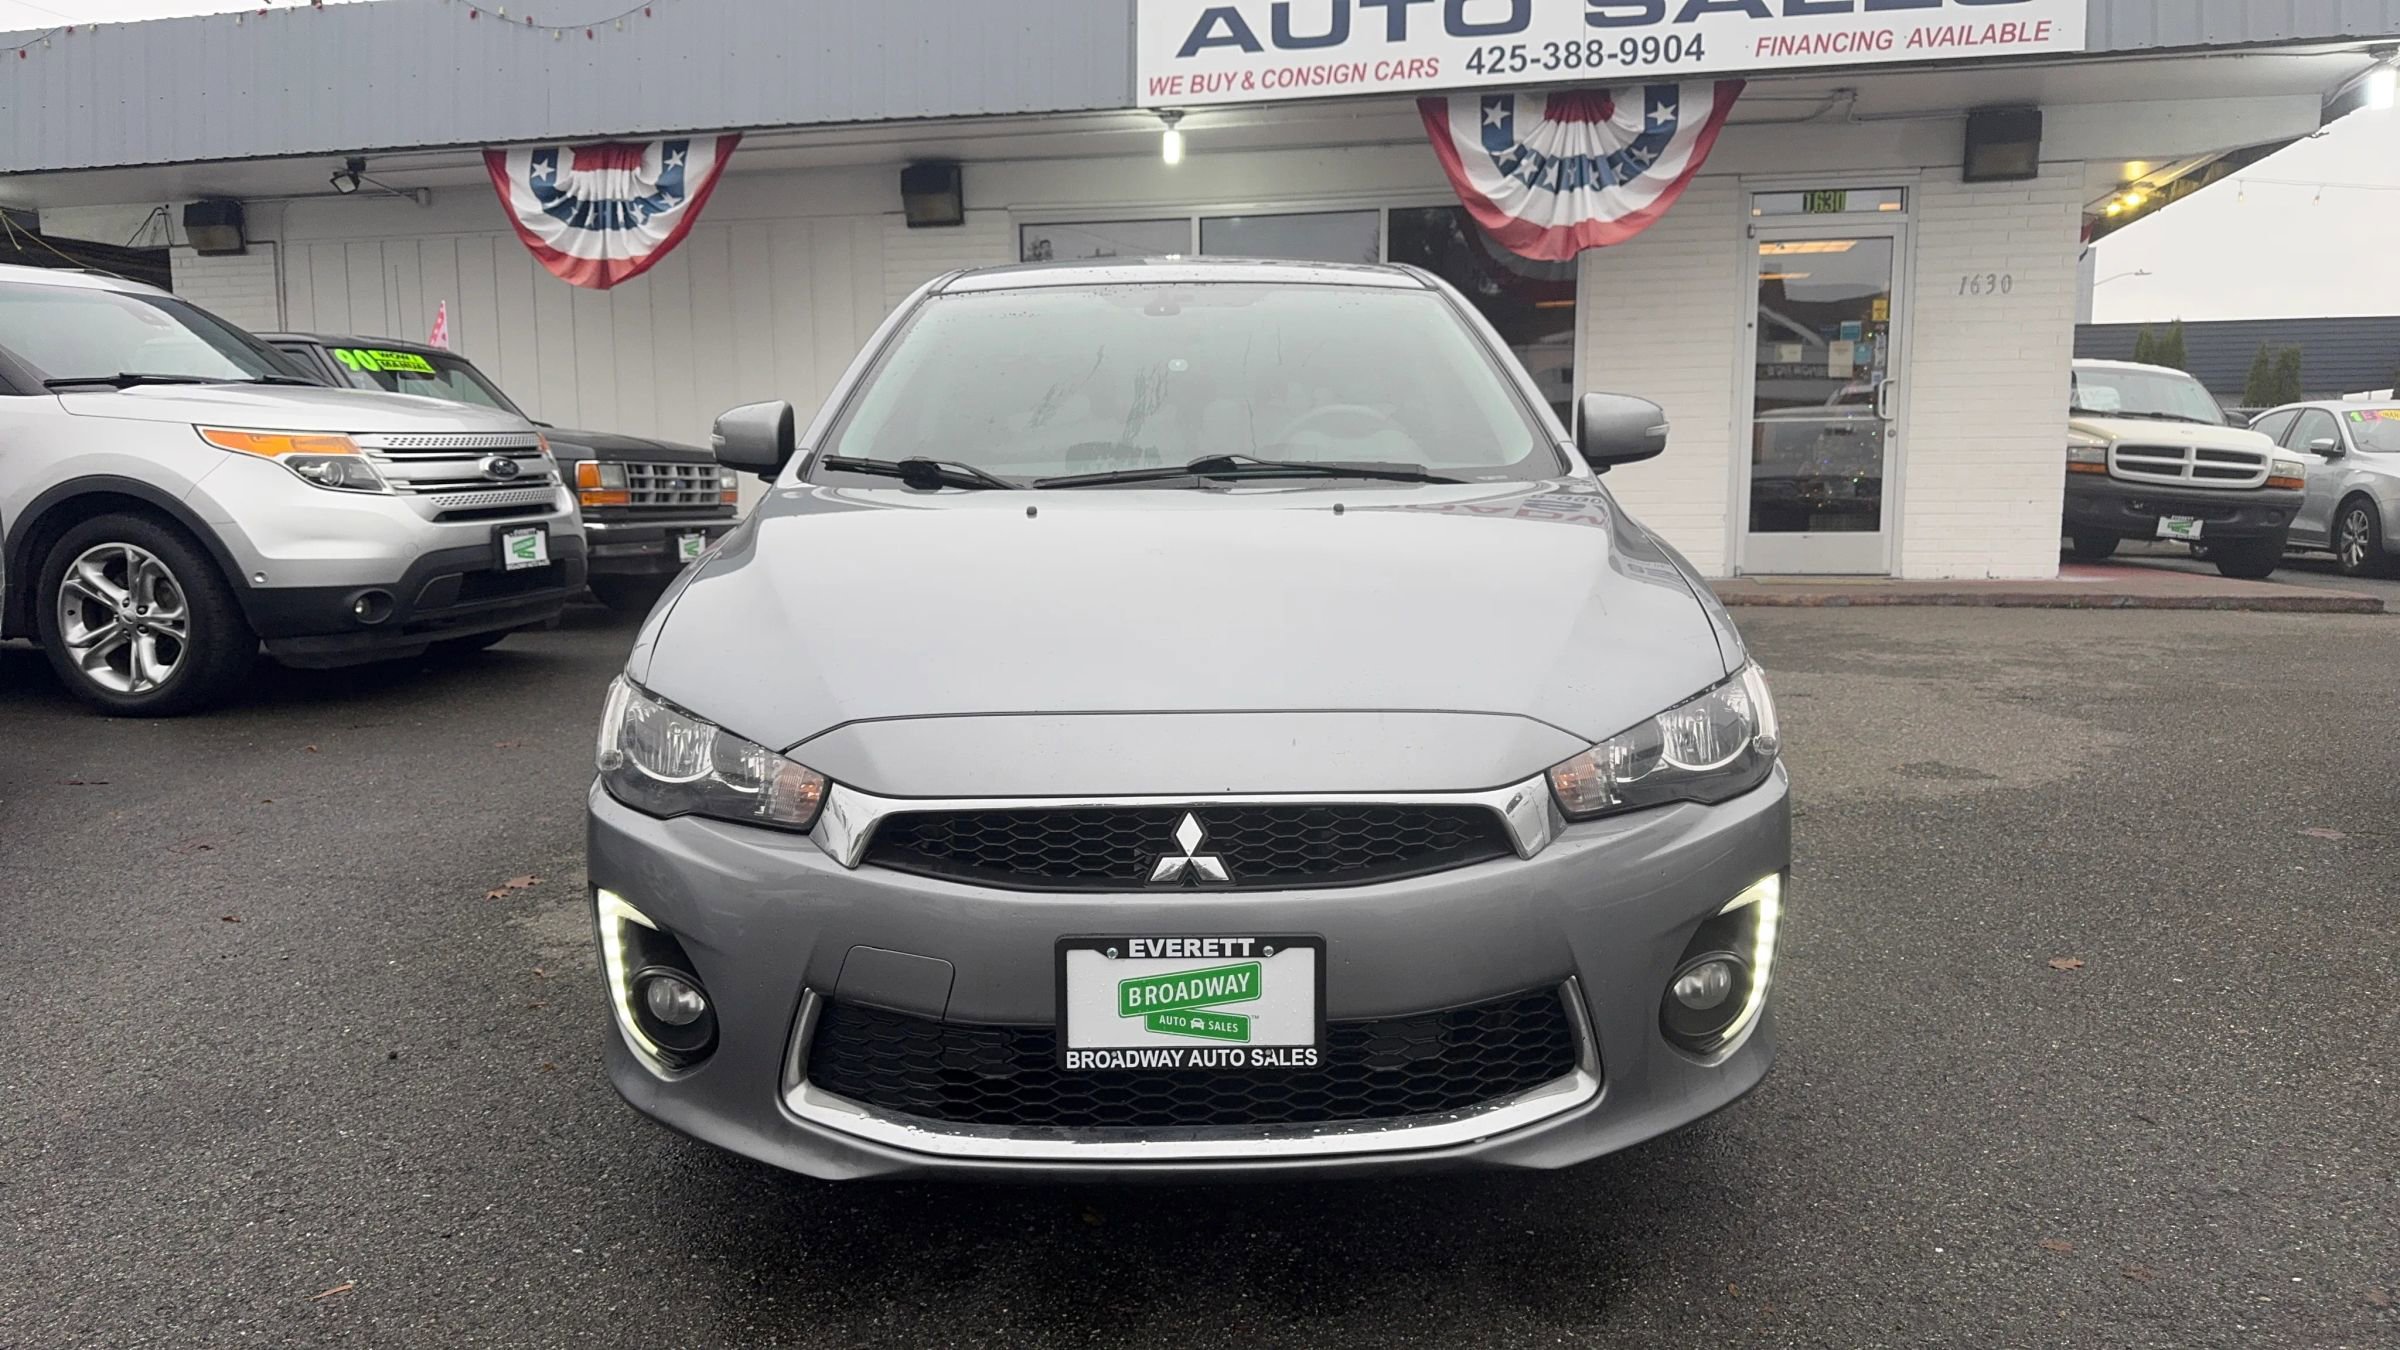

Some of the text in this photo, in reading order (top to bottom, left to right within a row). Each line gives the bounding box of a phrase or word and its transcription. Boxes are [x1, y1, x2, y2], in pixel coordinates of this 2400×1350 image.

[1175, 0, 1532, 58] AUTO
[1755, 20, 2052, 57] FINANCING AVAILABLE
[1466, 33, 1705, 76] 425-388-9904
[1149, 57, 1440, 96] WE BUY & CONSIGN CARS
[1804, 190, 1846, 213] 1630
[1958, 273, 2013, 296] 1630
[334, 348, 381, 371] 90
[1128, 938, 1255, 958] EVERETT
[1128, 972, 1250, 1007] BROADWAY
[1159, 1015, 1239, 1033] AUTO SALES
[1066, 1048, 1318, 1069] BROADWAY AUTO SALES
